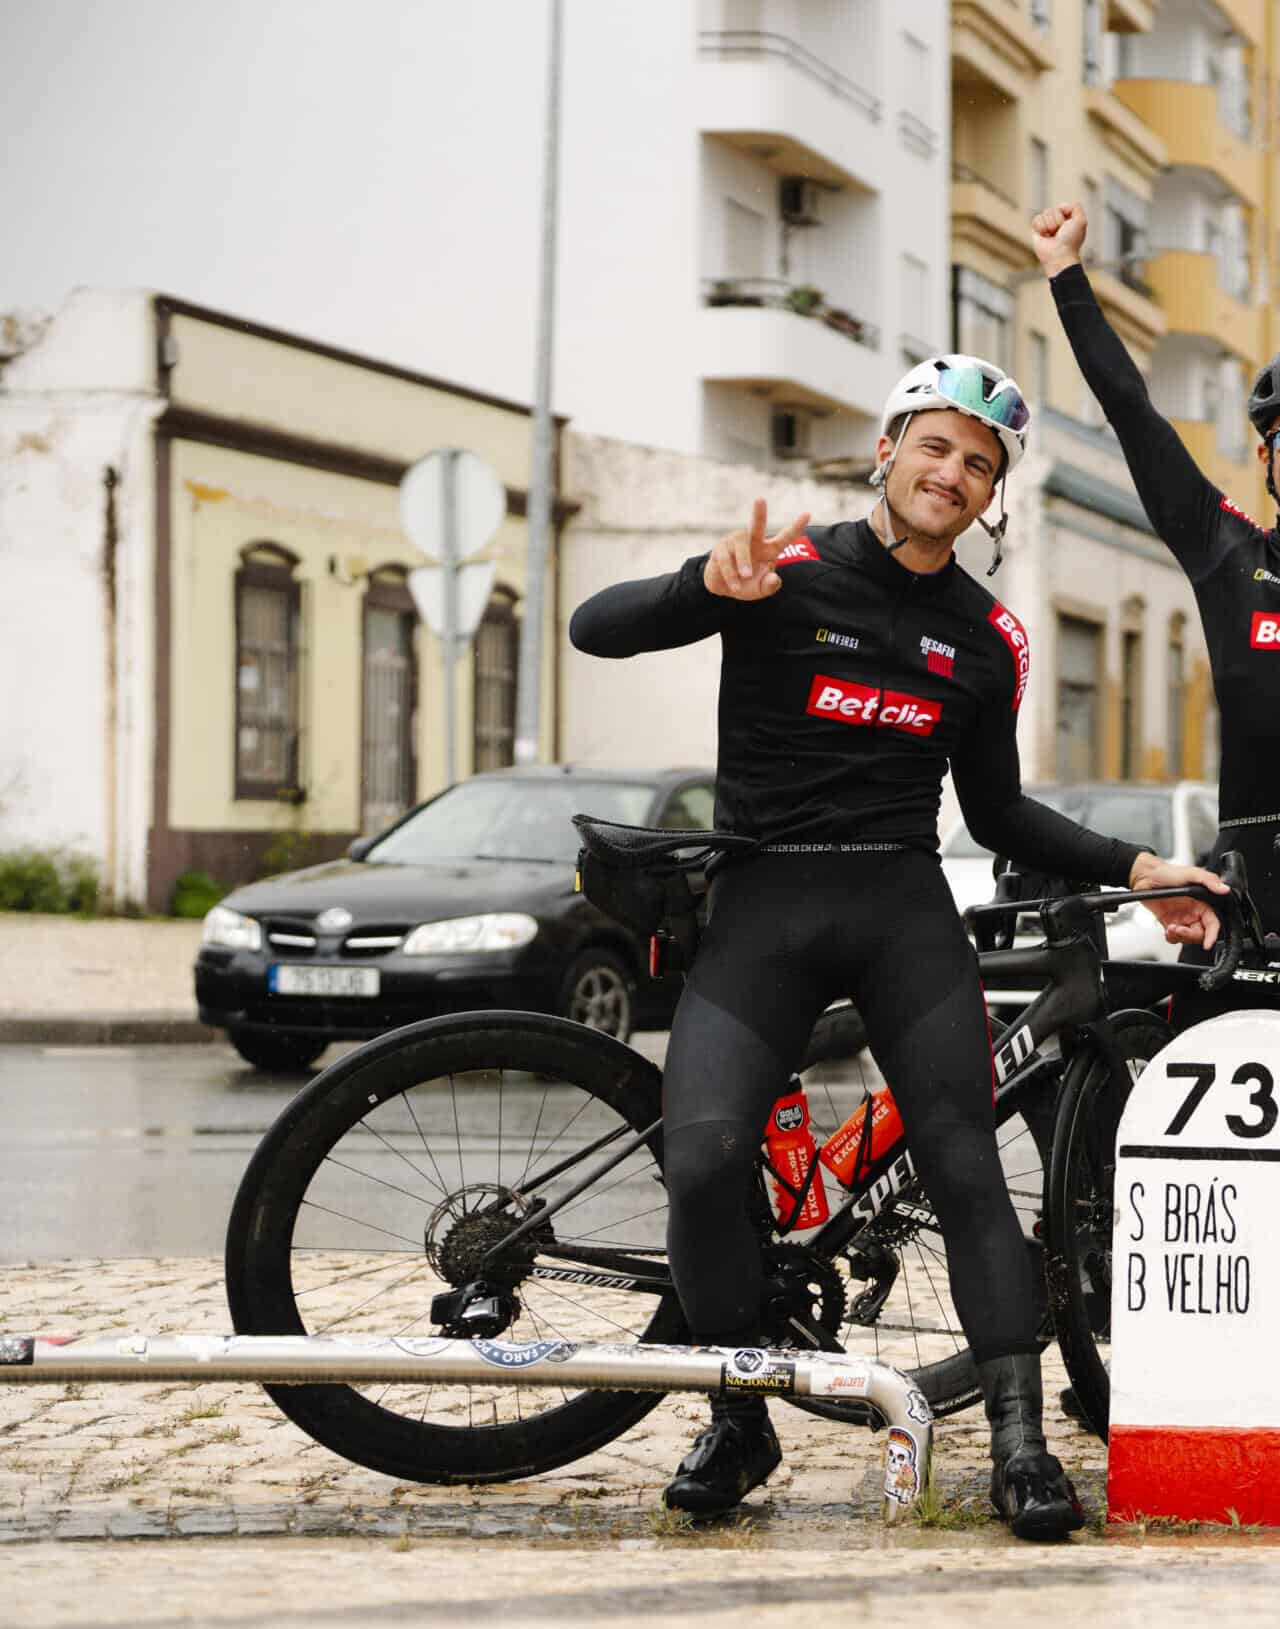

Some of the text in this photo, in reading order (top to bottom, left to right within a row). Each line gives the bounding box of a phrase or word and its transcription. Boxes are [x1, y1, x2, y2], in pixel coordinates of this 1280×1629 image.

[919, 635, 956, 660] DESAFIA
[995, 612, 1030, 702] Betclic
[815, 685, 934, 728] Betclic
[1129, 1182, 1145, 1241] S
[1164, 1177, 1237, 1243] BRÁS
[1127, 1253, 1146, 1312] B
[1164, 1254, 1250, 1314] VELHO
[502, 1349, 538, 1363] FARO
